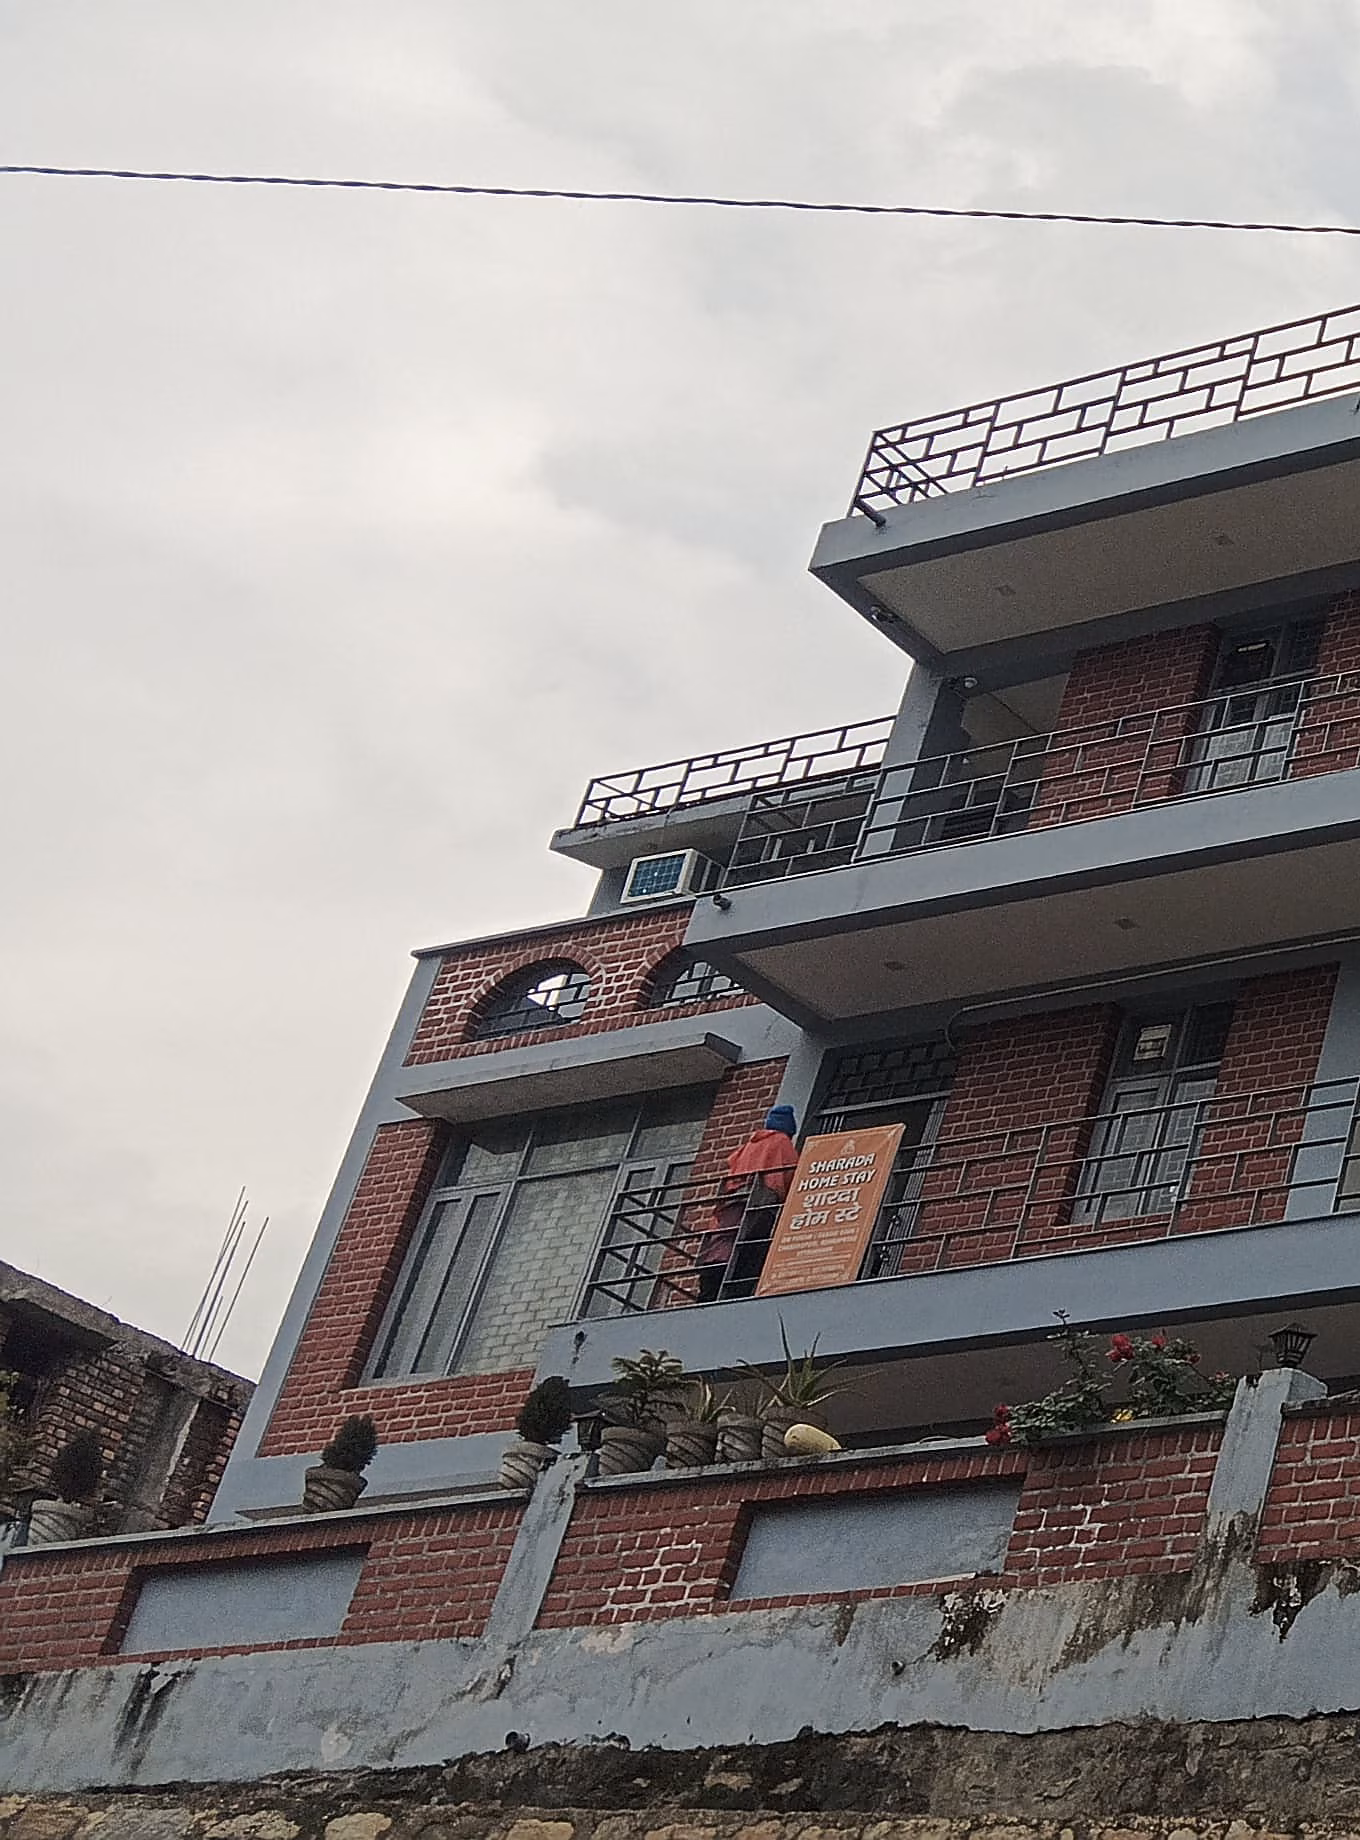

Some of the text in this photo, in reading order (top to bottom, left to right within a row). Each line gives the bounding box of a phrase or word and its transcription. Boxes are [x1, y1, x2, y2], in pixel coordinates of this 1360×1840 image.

[809, 1153, 876, 1174] SHARADA
[798, 1169, 876, 1192] HOME STAY
[802, 1187, 861, 1208] शारदा
[790, 1203, 863, 1230] होम स्टे
